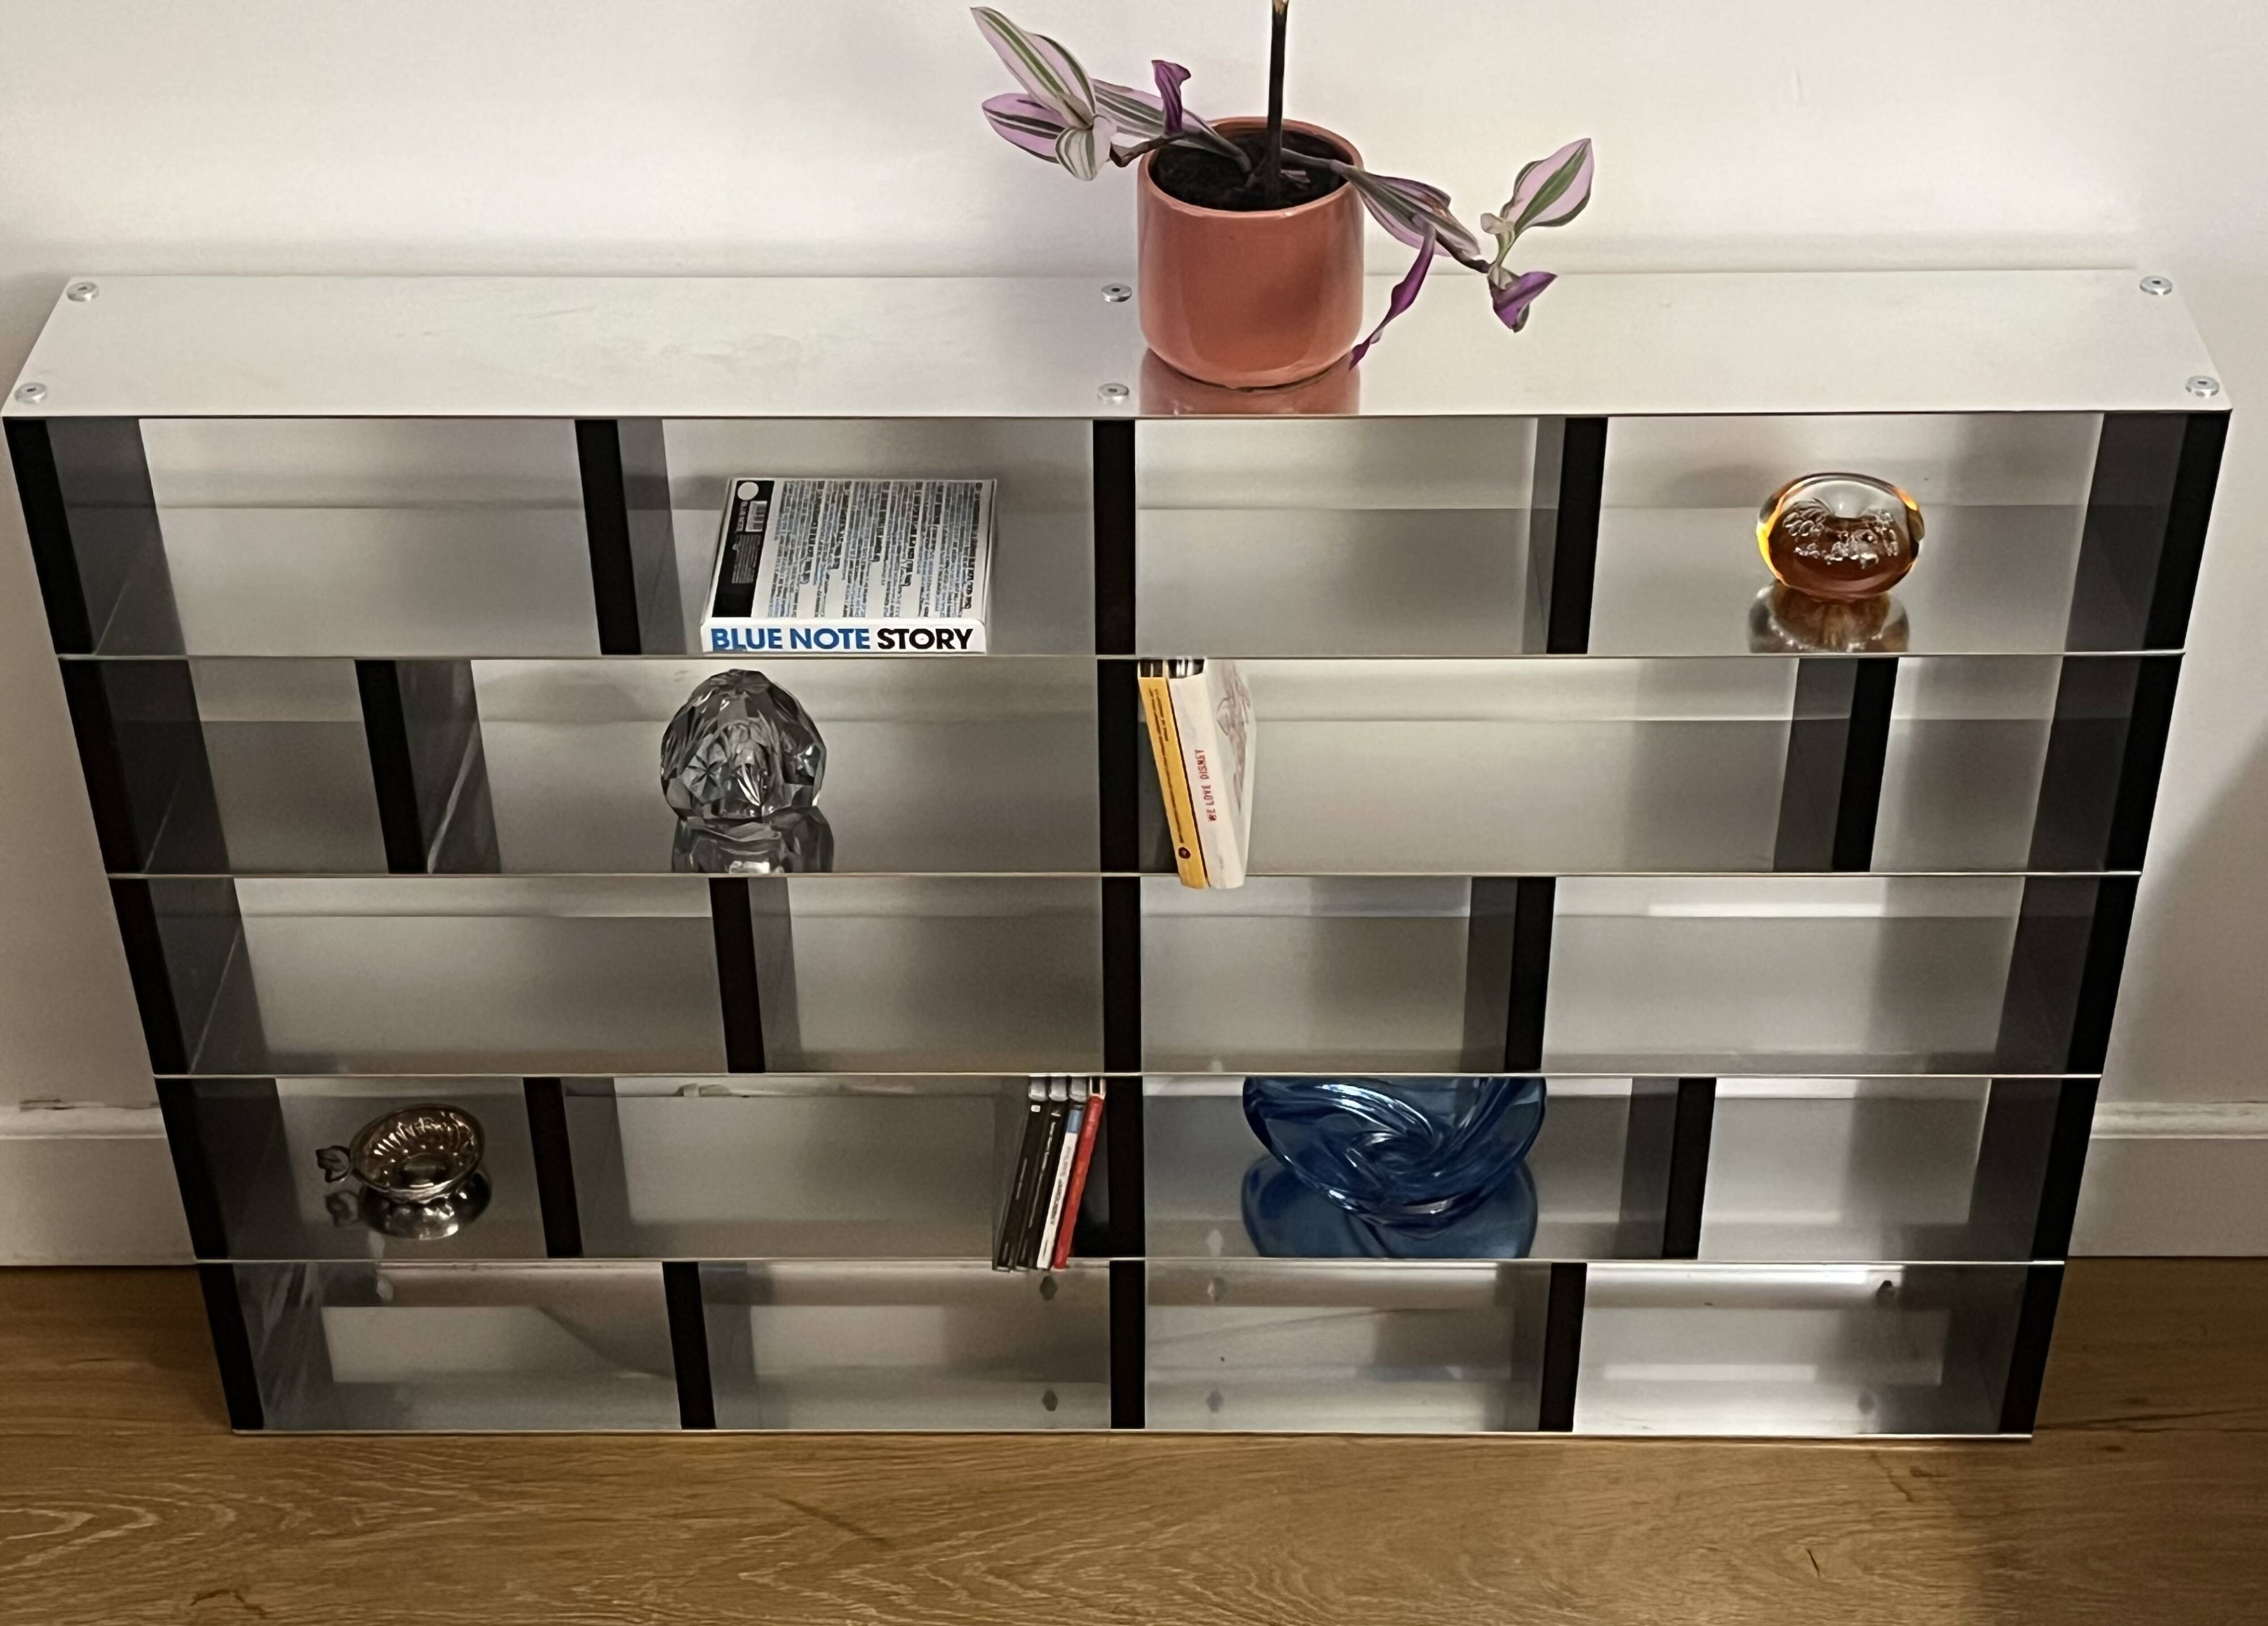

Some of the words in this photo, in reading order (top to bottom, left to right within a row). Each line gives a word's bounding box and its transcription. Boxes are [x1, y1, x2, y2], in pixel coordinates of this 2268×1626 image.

[711, 628, 782, 649] BLUE
[790, 628, 870, 649] NOTE
[877, 628, 974, 649] STORY
[1194, 749, 1209, 779] DISNEY
[1201, 785, 1215, 805] LOVE
[1206, 808, 1217, 821] WE
